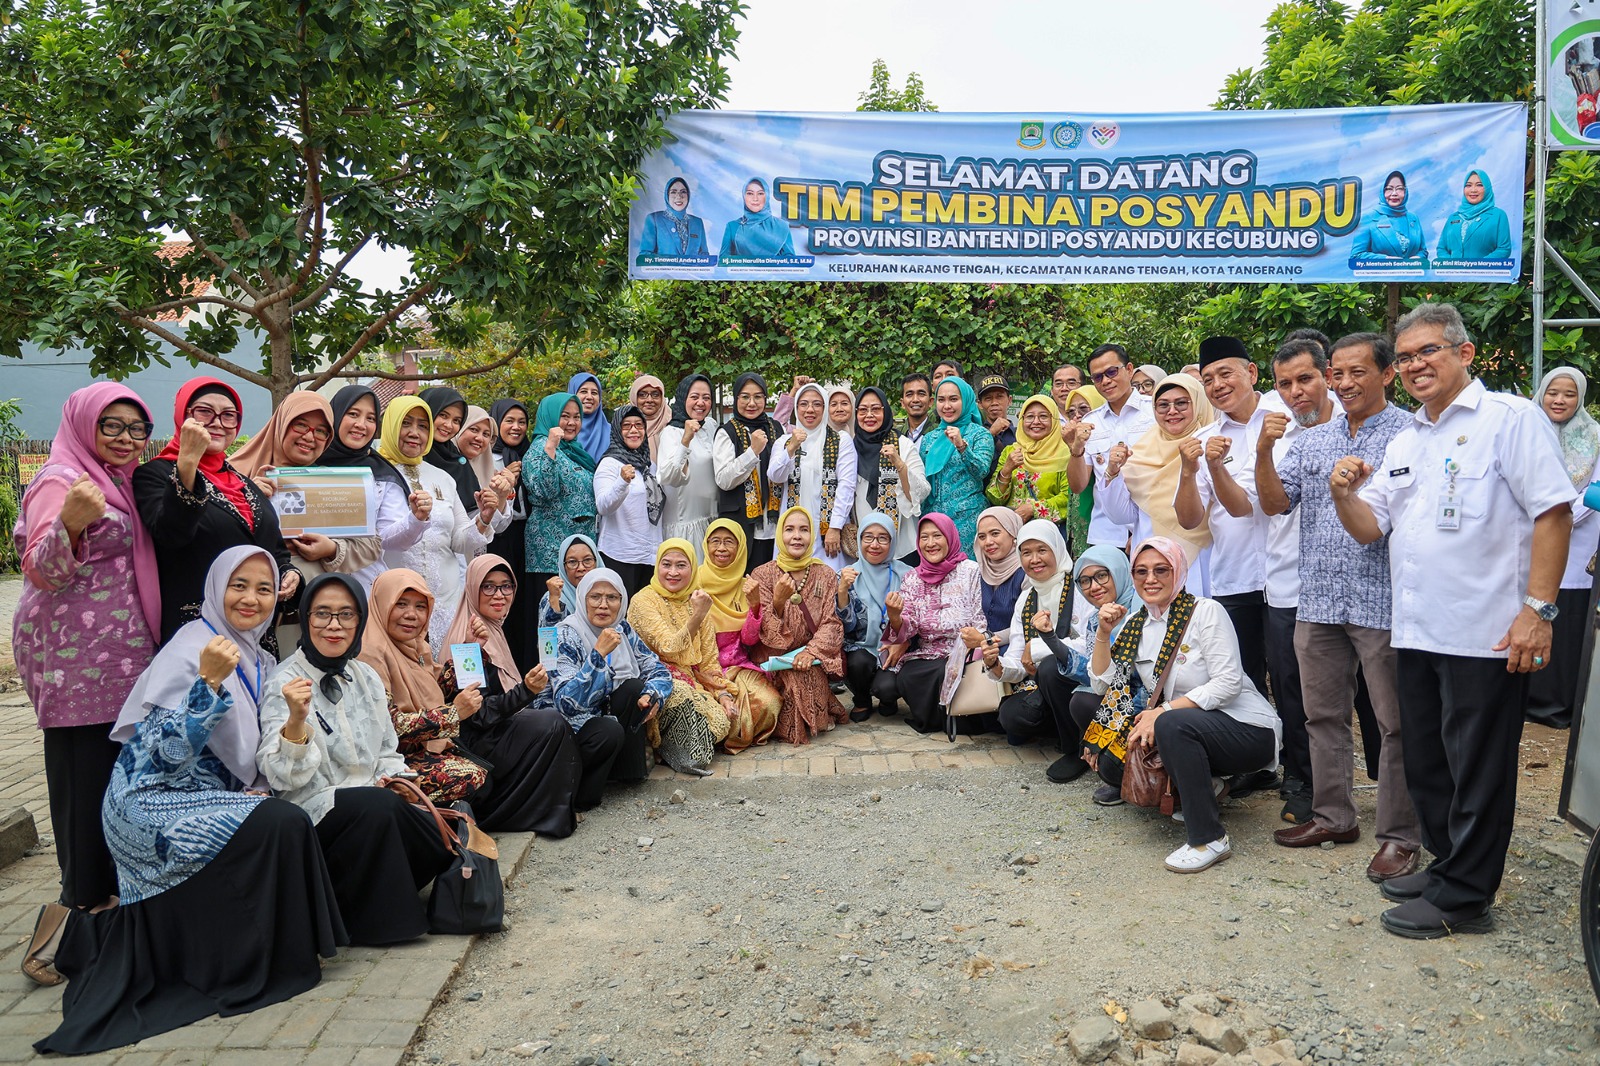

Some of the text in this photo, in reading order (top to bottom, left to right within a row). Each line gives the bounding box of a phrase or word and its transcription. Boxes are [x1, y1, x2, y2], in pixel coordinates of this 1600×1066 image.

[879, 156, 1250, 190] SELAMAT DATANG
[779, 183, 1356, 228] TIM PEMBINA POSYANDU
[814, 229, 1318, 250] PROVINSI BANTEN DI POSYANDU KECUBUNG
[828, 263, 1303, 276] KELURAHAN KARANG TENGAH, KECAMATAN KARANG TENGAH, KOTA TANGERANG
[982, 377, 1003, 388] NKRI
